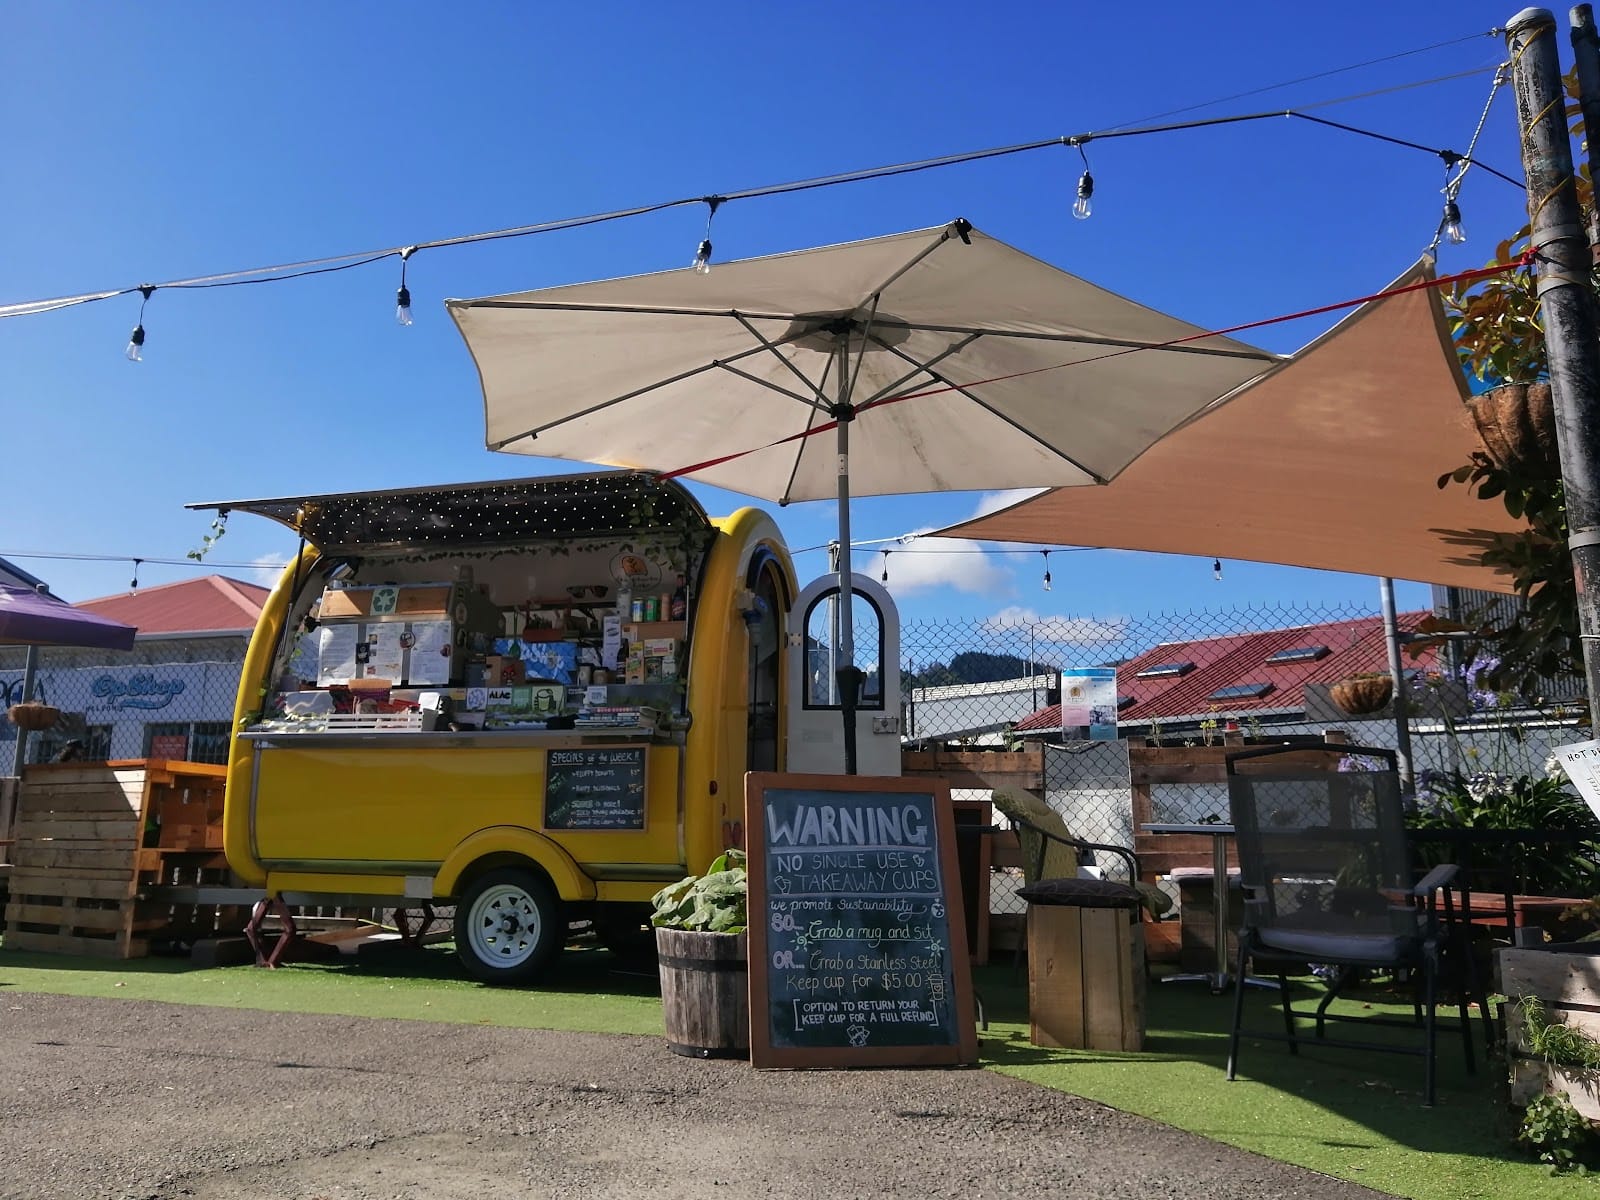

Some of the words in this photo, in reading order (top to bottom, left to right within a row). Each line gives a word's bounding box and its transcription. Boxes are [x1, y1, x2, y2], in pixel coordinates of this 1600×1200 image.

[489, 690, 511, 699] ALAC
[610, 752, 633, 762] WEEK
[1568, 749, 1587, 762] HOT
[766, 804, 928, 846] WARNING
[777, 854, 803, 873] NO
[812, 853, 866, 870] SINGLE
[877, 852, 908, 869] USE
[794, 871, 889, 892] TAKEAWAY
[892, 870, 937, 890] CUPS
[790, 899, 833, 915] promote
[808, 919, 843, 940] Grab
[845, 928, 855, 938] a
[857, 928, 882, 948] mug
[888, 924, 910, 939] and
[809, 949, 844, 970] Grab
[846, 960, 854, 970] a
[786, 975, 820, 997] Keep
[824, 977, 845, 995] cup
[852, 974, 873, 993] for
[881, 972, 922, 990] $5.00
[803, 1001, 838, 1013] OPTION
[842, 1001, 855, 1012] TO
[857, 1000, 896, 1012] RETURN
[897, 999, 920, 1010] YOUR
[801, 1014, 825, 1025] KEEP
[828, 1013, 846, 1024] CUP
[850, 1012, 866, 1023] FOR
[870, 1013, 877, 1023] A
[880, 1012, 900, 1023] FULL
[901, 1011, 935, 1022] REFUND
